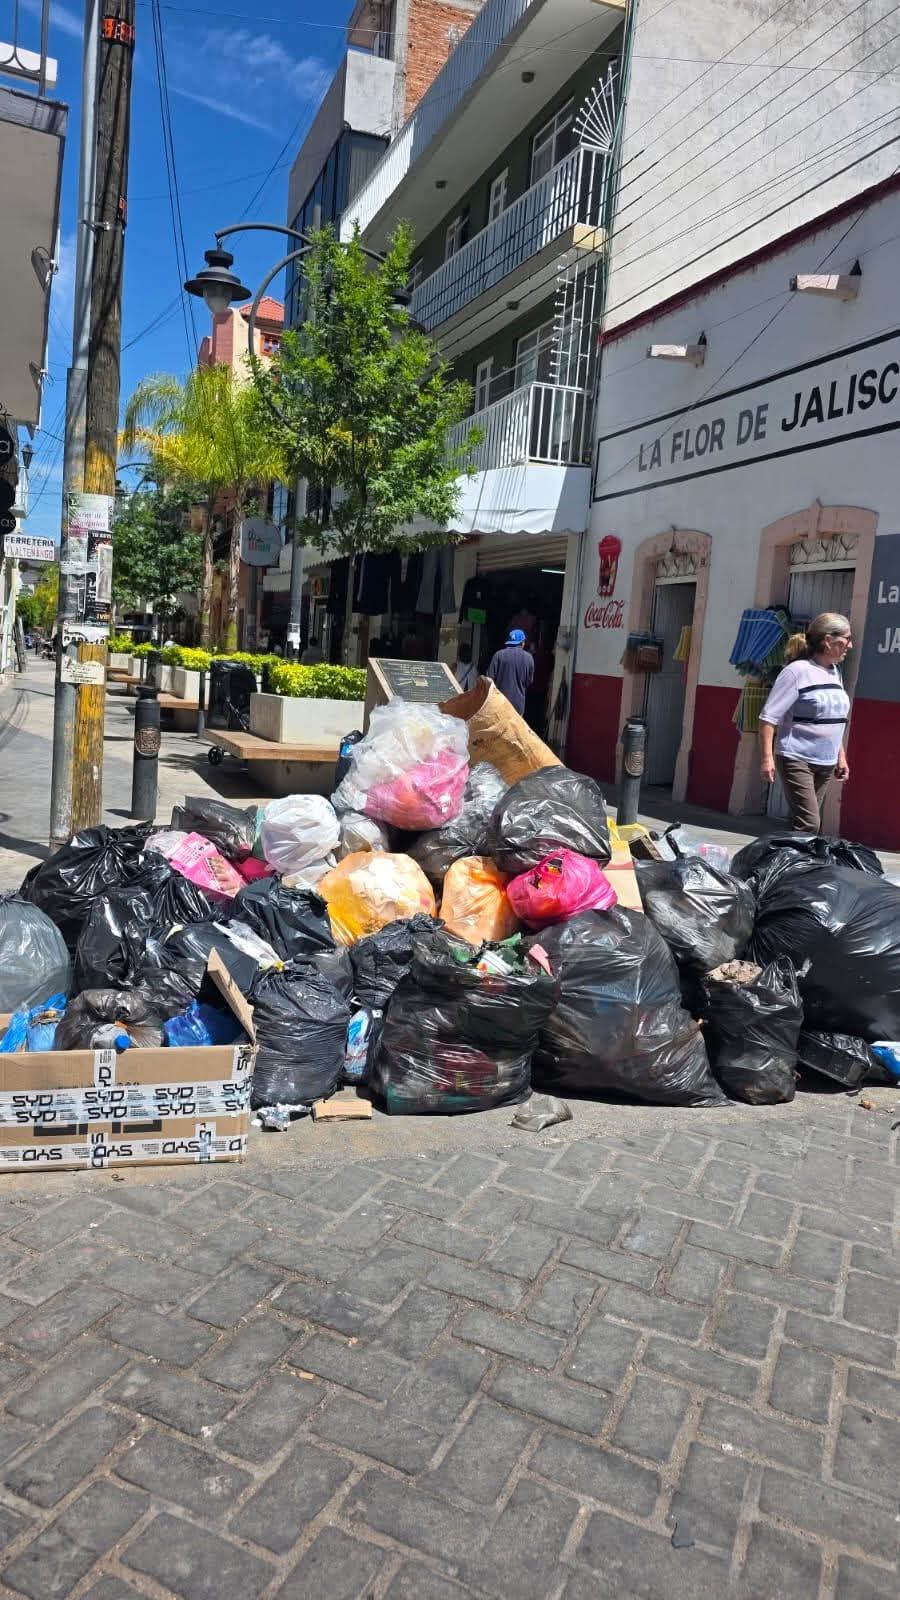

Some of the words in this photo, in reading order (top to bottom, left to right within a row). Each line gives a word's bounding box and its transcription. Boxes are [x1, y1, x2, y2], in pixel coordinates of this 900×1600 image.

[638, 439, 662, 472] LA
[670, 417, 726, 464] FLOR
[736, 403, 769, 446] DE
[781, 362, 900, 432] JALISC
[5, 535, 54, 547] FERRETERIA
[12, 1095, 53, 1107] SYD
[84, 1090, 125, 1103] SYD
[155, 1087, 194, 1100] SYD
[16, 1110, 56, 1122] SYD
[88, 1106, 128, 1119] SYD
[157, 1102, 196, 1116] SYD
